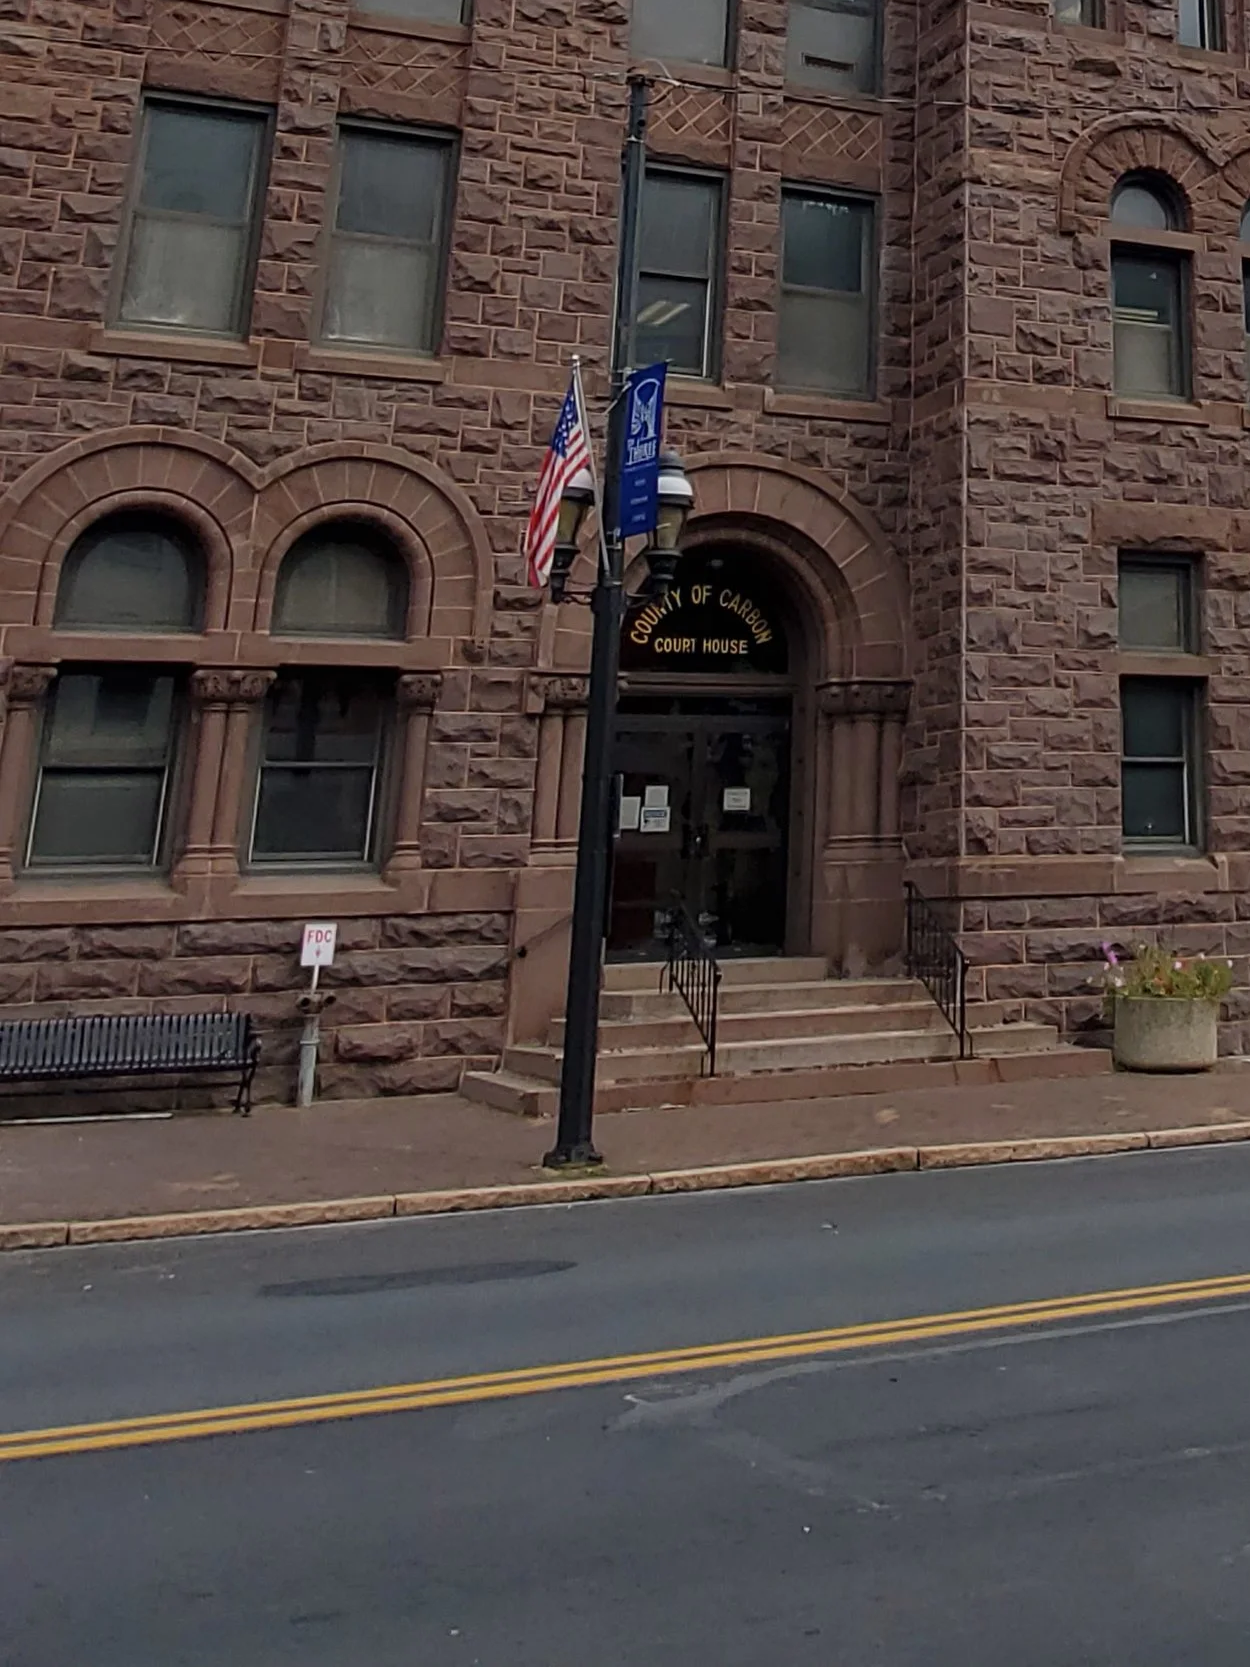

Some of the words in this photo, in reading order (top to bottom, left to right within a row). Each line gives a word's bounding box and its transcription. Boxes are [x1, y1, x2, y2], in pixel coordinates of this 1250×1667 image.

[691, 585, 712, 605] OF
[719, 588, 773, 645] CARBON
[654, 637, 696, 653] COURT
[702, 638, 749, 654] HOUSE
[307, 929, 332, 943] FDC
